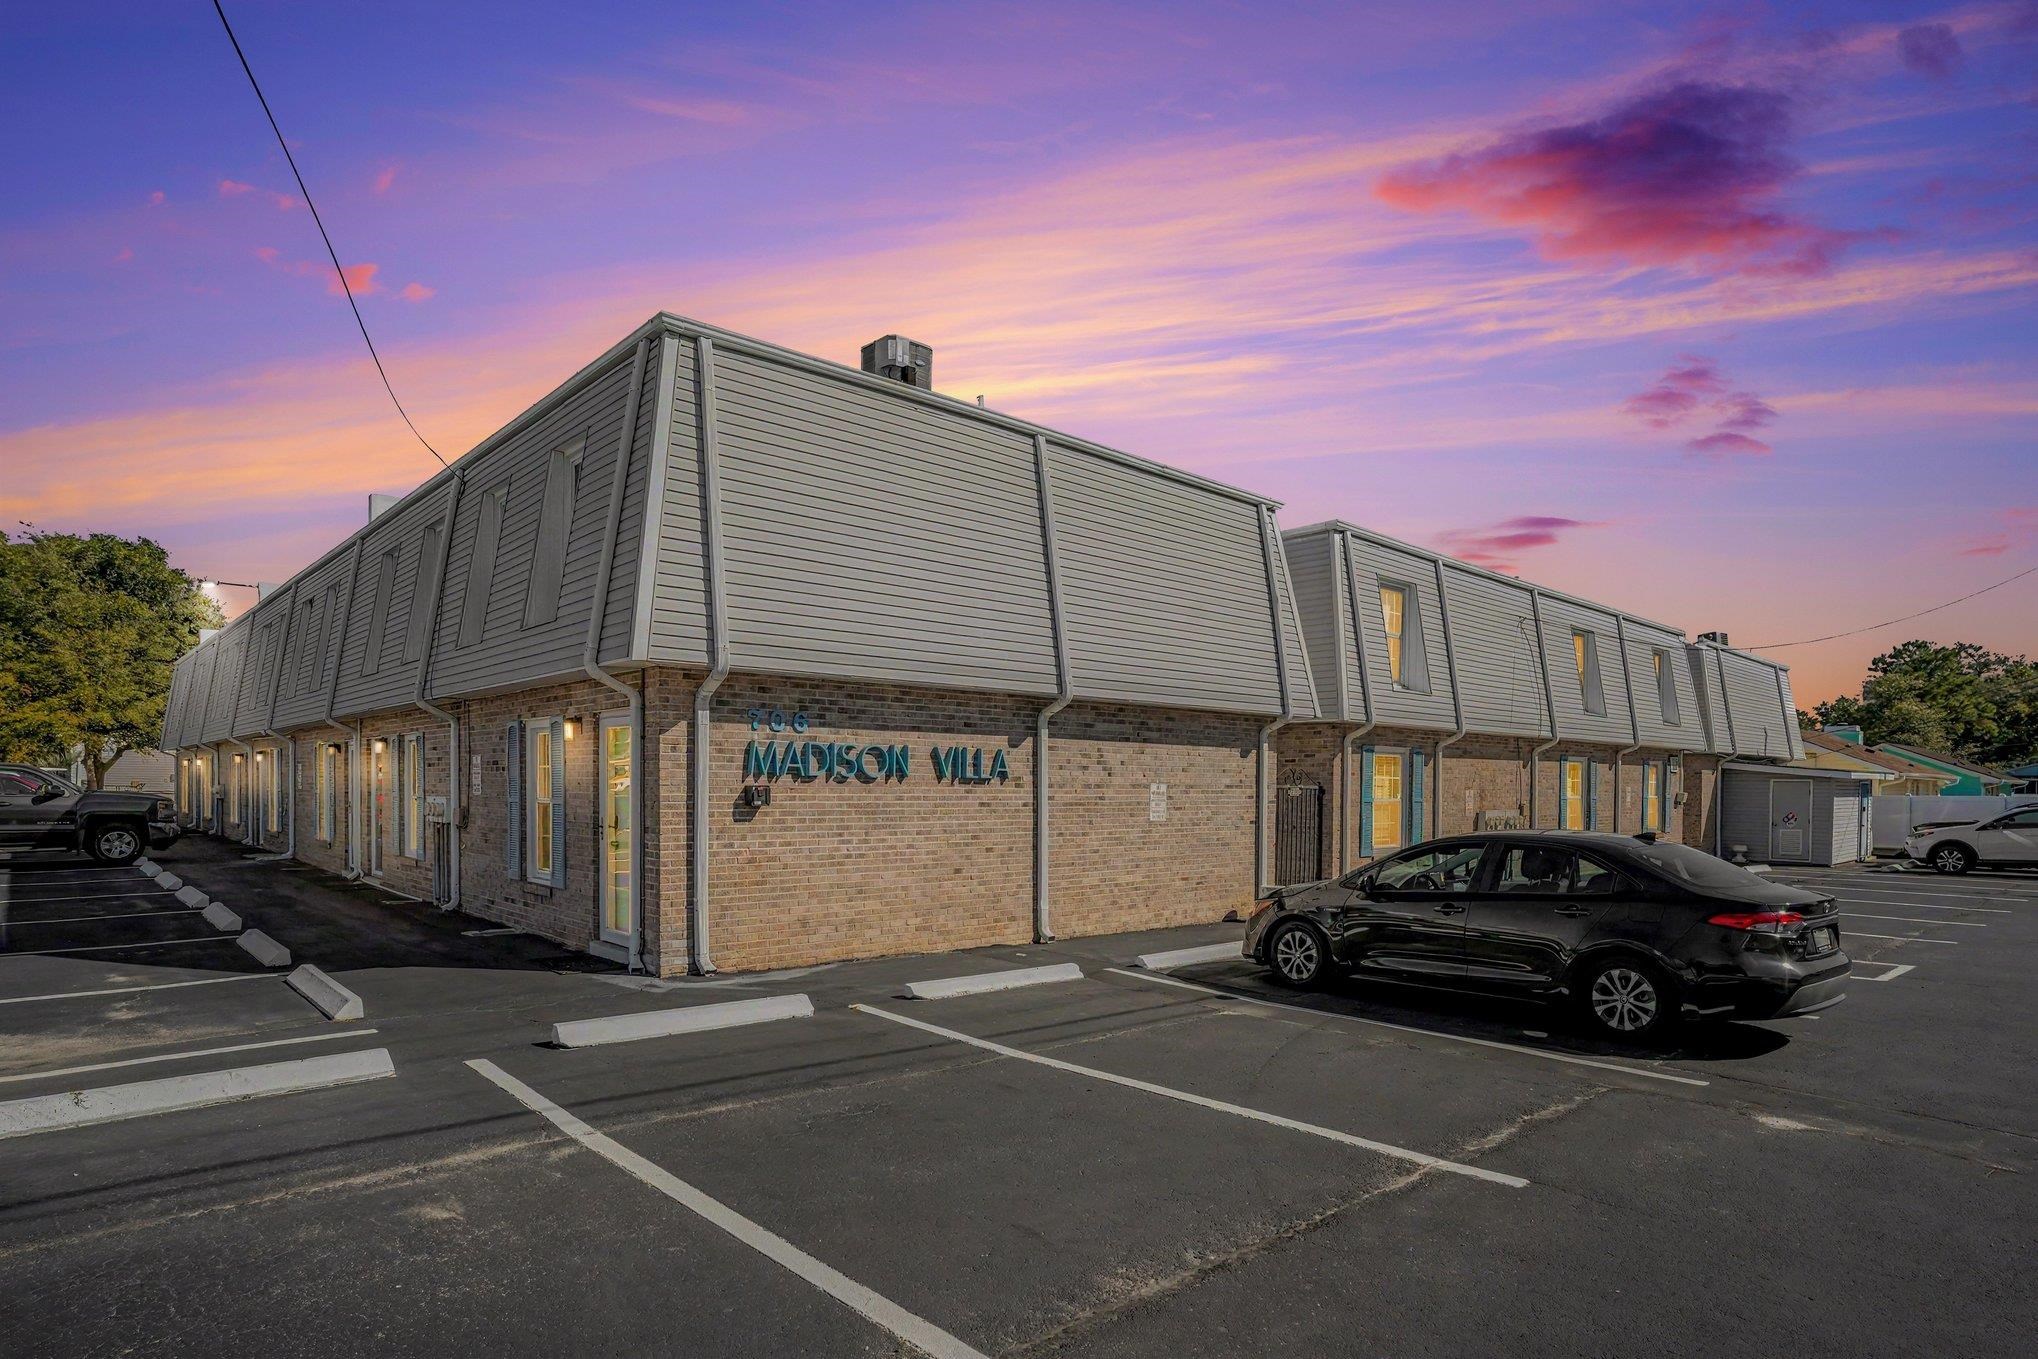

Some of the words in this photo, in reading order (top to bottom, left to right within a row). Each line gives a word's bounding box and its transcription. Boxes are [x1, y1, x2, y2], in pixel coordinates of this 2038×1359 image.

[746, 709, 809, 733] 706
[745, 740, 910, 779] MADISON
[931, 746, 1010, 780] VILLA
